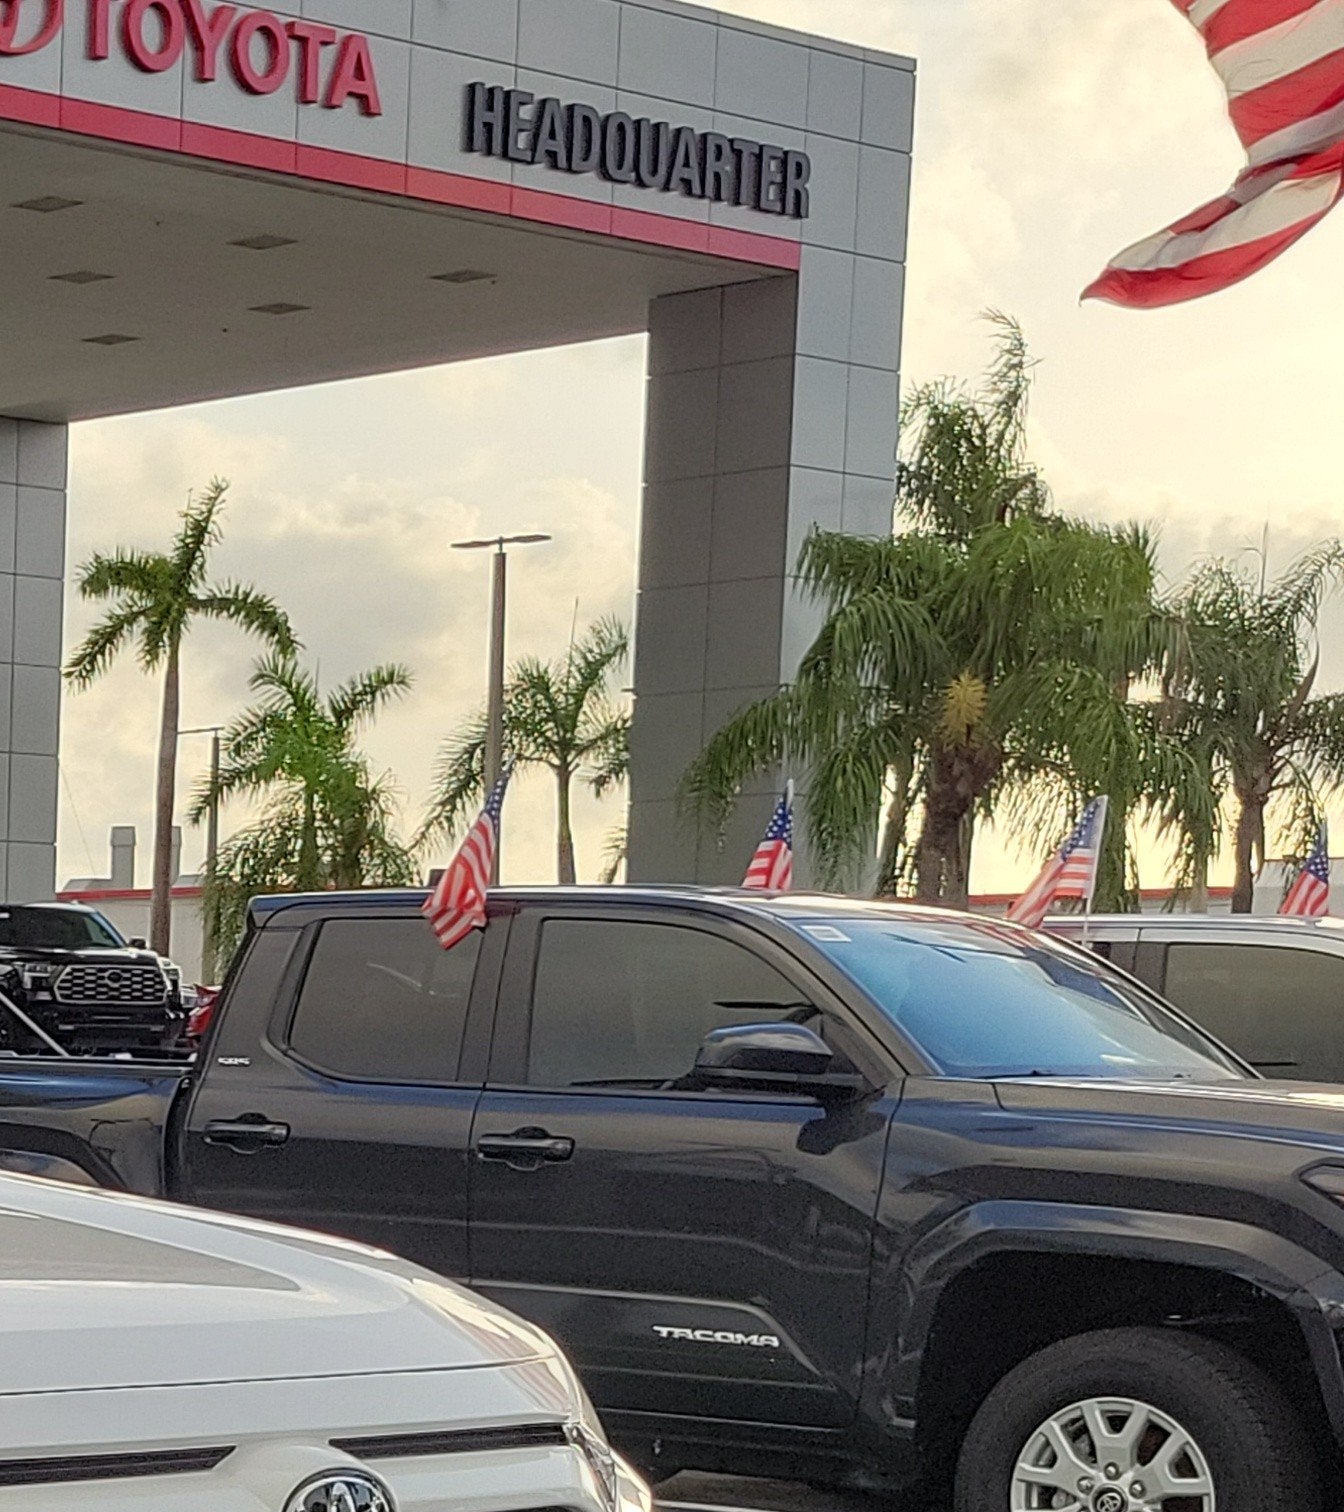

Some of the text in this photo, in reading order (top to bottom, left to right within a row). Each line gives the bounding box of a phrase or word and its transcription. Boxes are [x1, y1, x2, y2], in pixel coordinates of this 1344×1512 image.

[86, 0, 381, 116] TOYOTA
[464, 82, 811, 218] HEADQUARTER
[653, 1326, 779, 1347] TACOMA
